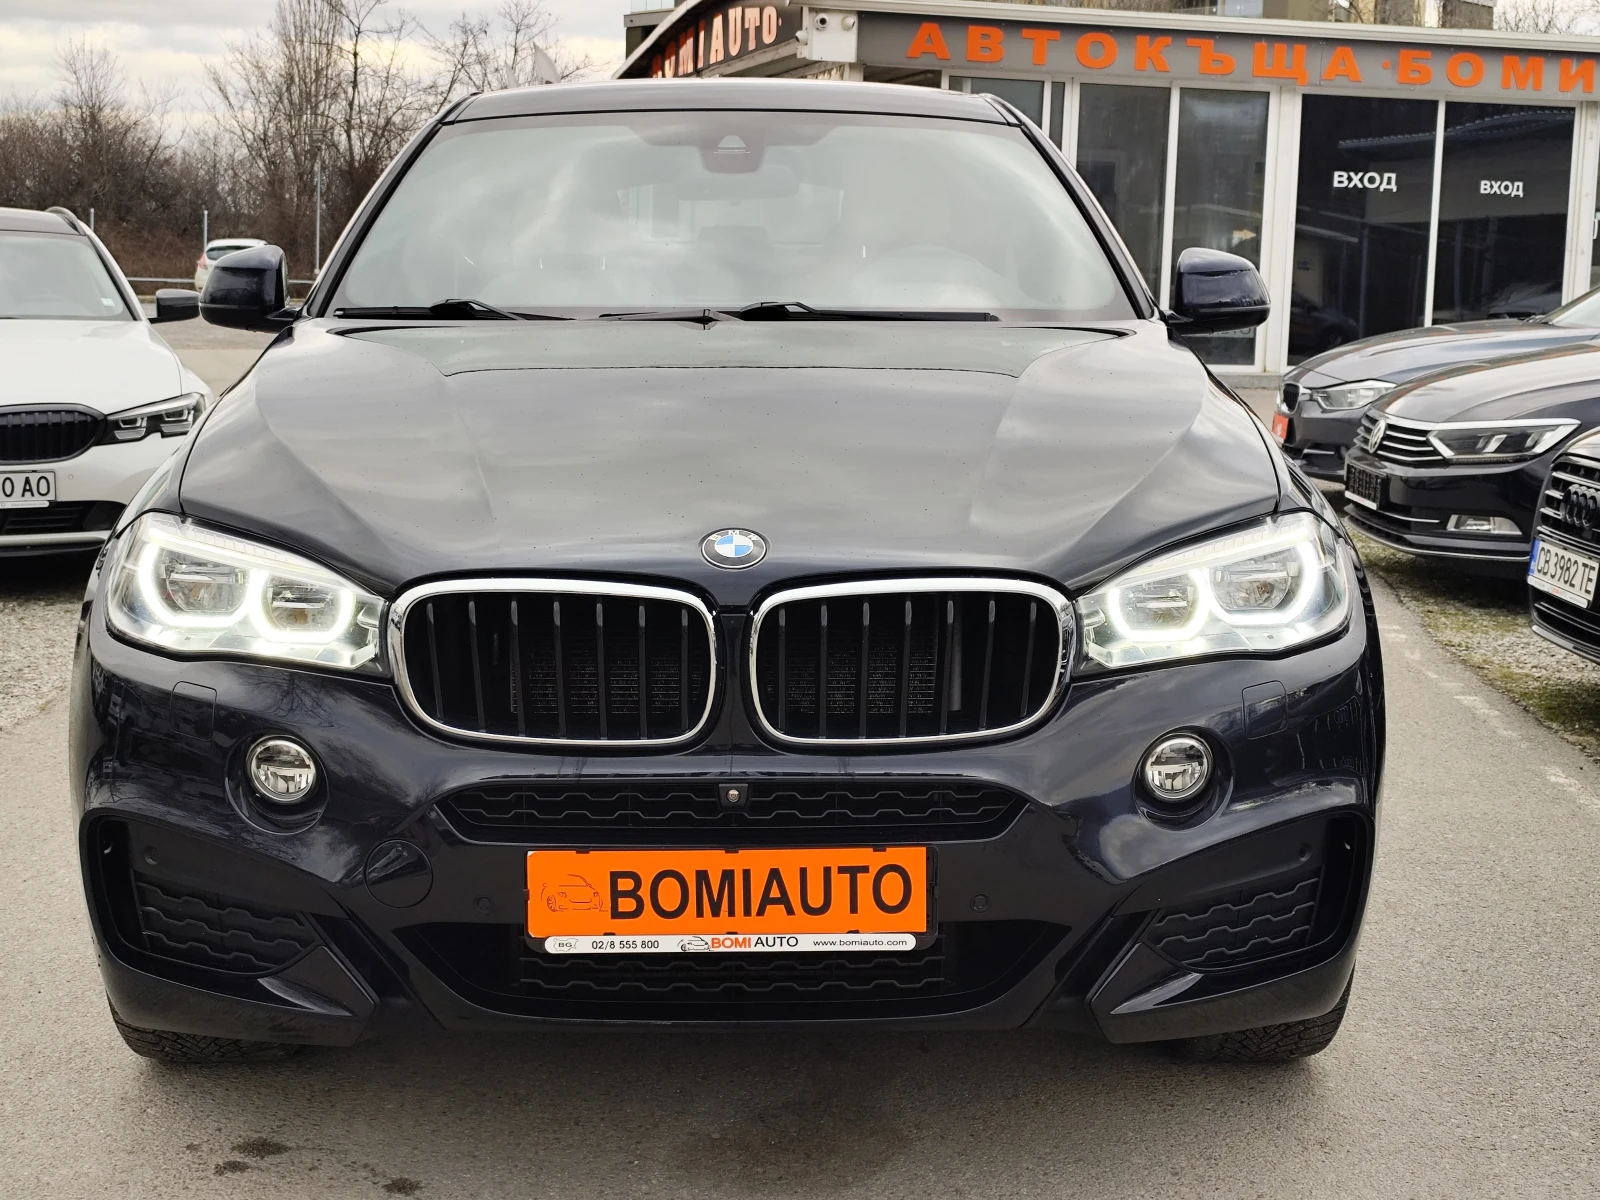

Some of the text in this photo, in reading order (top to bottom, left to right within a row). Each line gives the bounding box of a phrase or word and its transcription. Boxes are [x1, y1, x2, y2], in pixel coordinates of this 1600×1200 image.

[1333, 171, 1397, 192] ВХОД
[1480, 180, 1524, 197] ВХОД
[21, 476, 50, 497] AO
[1537, 546, 1552, 576] CB
[1550, 552, 1578, 588] 3982
[1580, 562, 1596, 595] TE
[609, 863, 913, 919] BOMIAUTO
[591, 939, 660, 951] 02/8 555 800
[711, 936, 799, 949] BOMI AUTO
[812, 938, 908, 947] www.bomiauto.com
